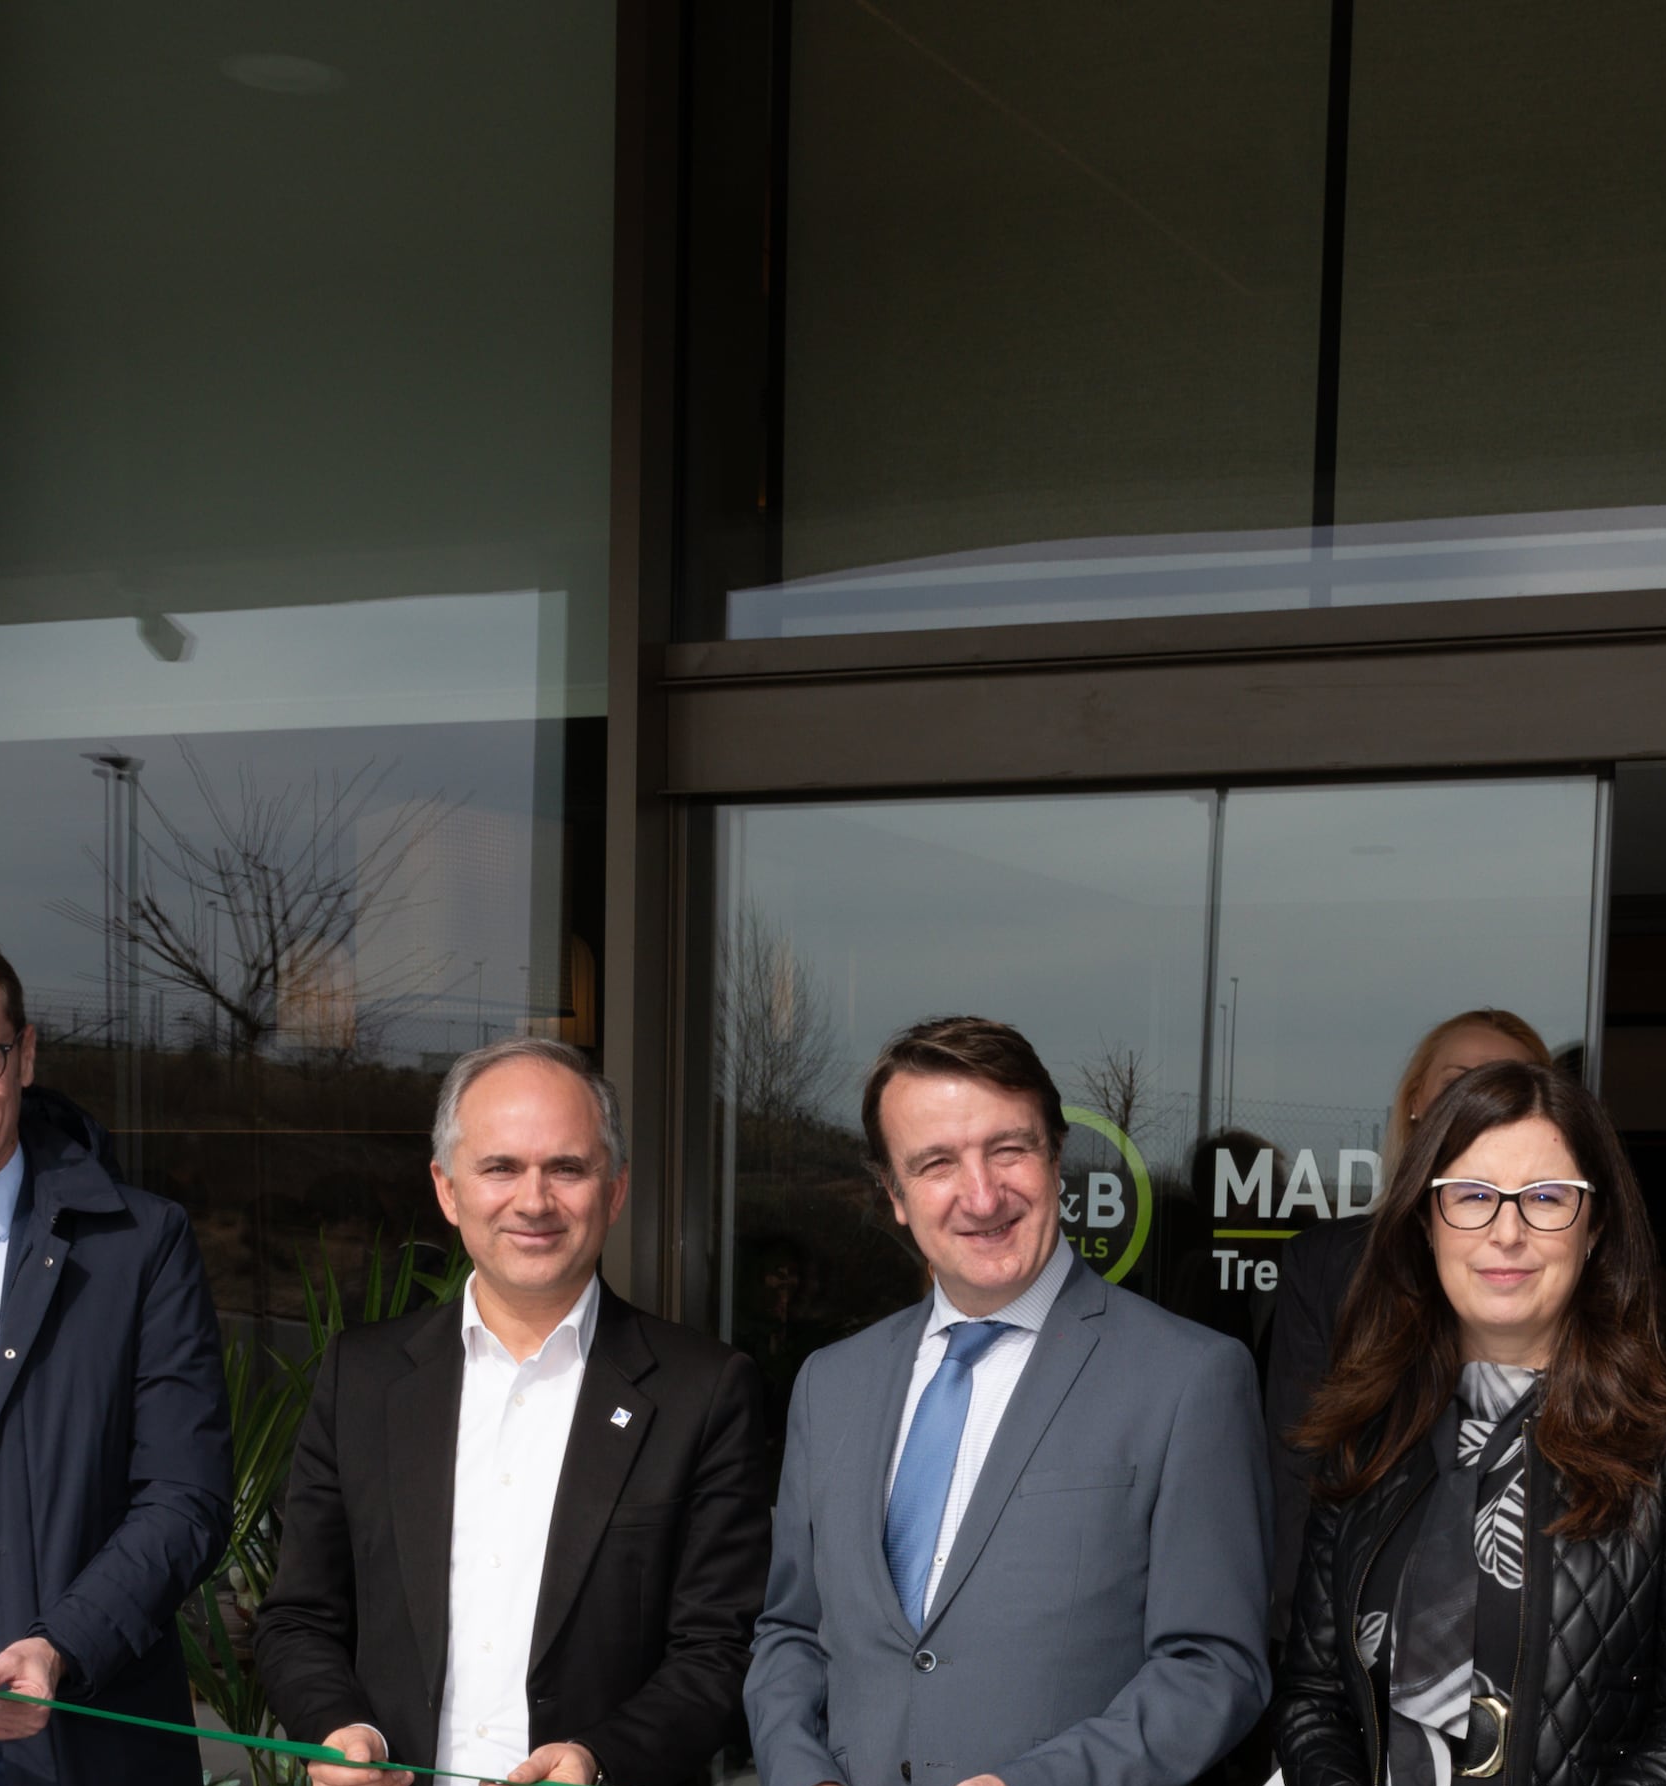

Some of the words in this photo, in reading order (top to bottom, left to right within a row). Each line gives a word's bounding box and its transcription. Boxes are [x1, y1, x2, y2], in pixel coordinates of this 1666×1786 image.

[1058, 1171, 1126, 1229] &B
[1213, 1148, 1386, 1219] MAD
[1212, 1249, 1279, 1292] Tre
